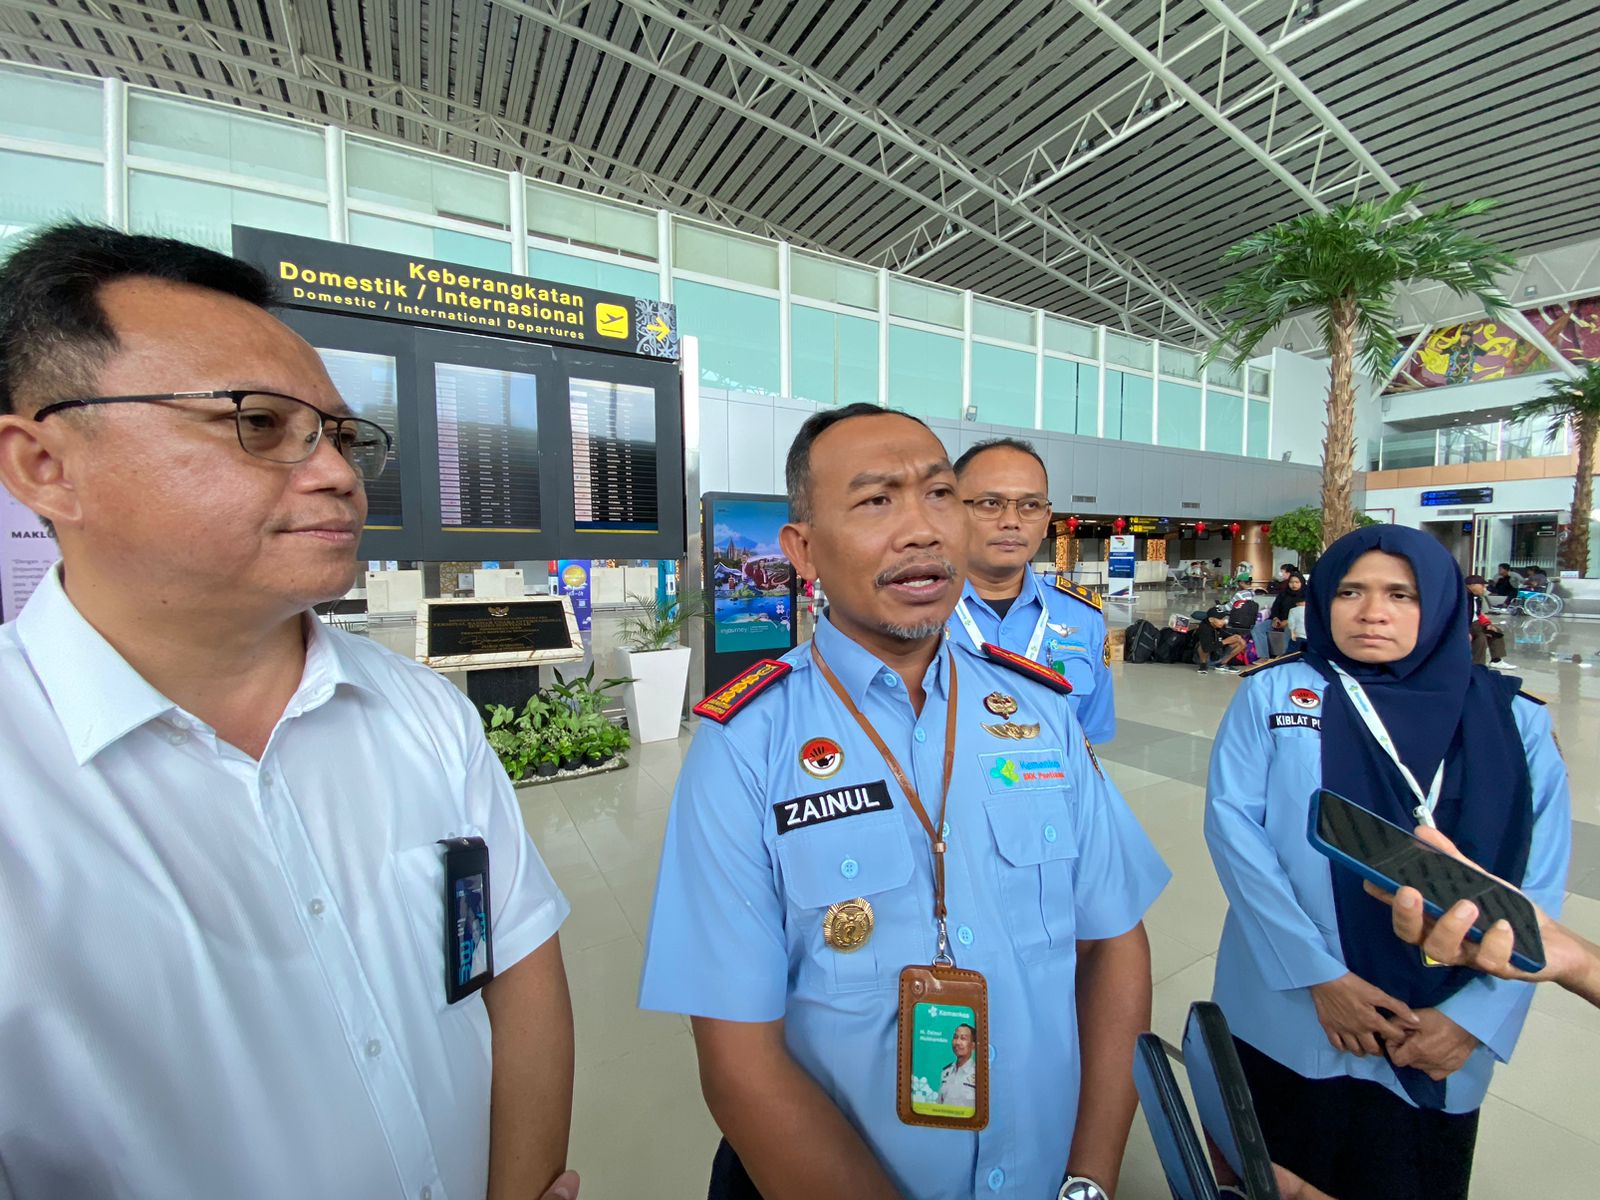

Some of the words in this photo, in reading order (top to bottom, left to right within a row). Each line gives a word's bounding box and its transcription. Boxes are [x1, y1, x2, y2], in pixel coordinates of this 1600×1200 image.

[279, 261, 408, 298] Domestik
[417, 284, 426, 300] /
[436, 287, 584, 326] Internasional
[409, 262, 584, 308] Keberangkatan
[293, 287, 377, 309] Domestic
[397, 302, 501, 327] International
[507, 319, 585, 340] Departures
[1275, 715, 1308, 726] KIBLAT
[784, 787, 881, 826] ZAINUL
